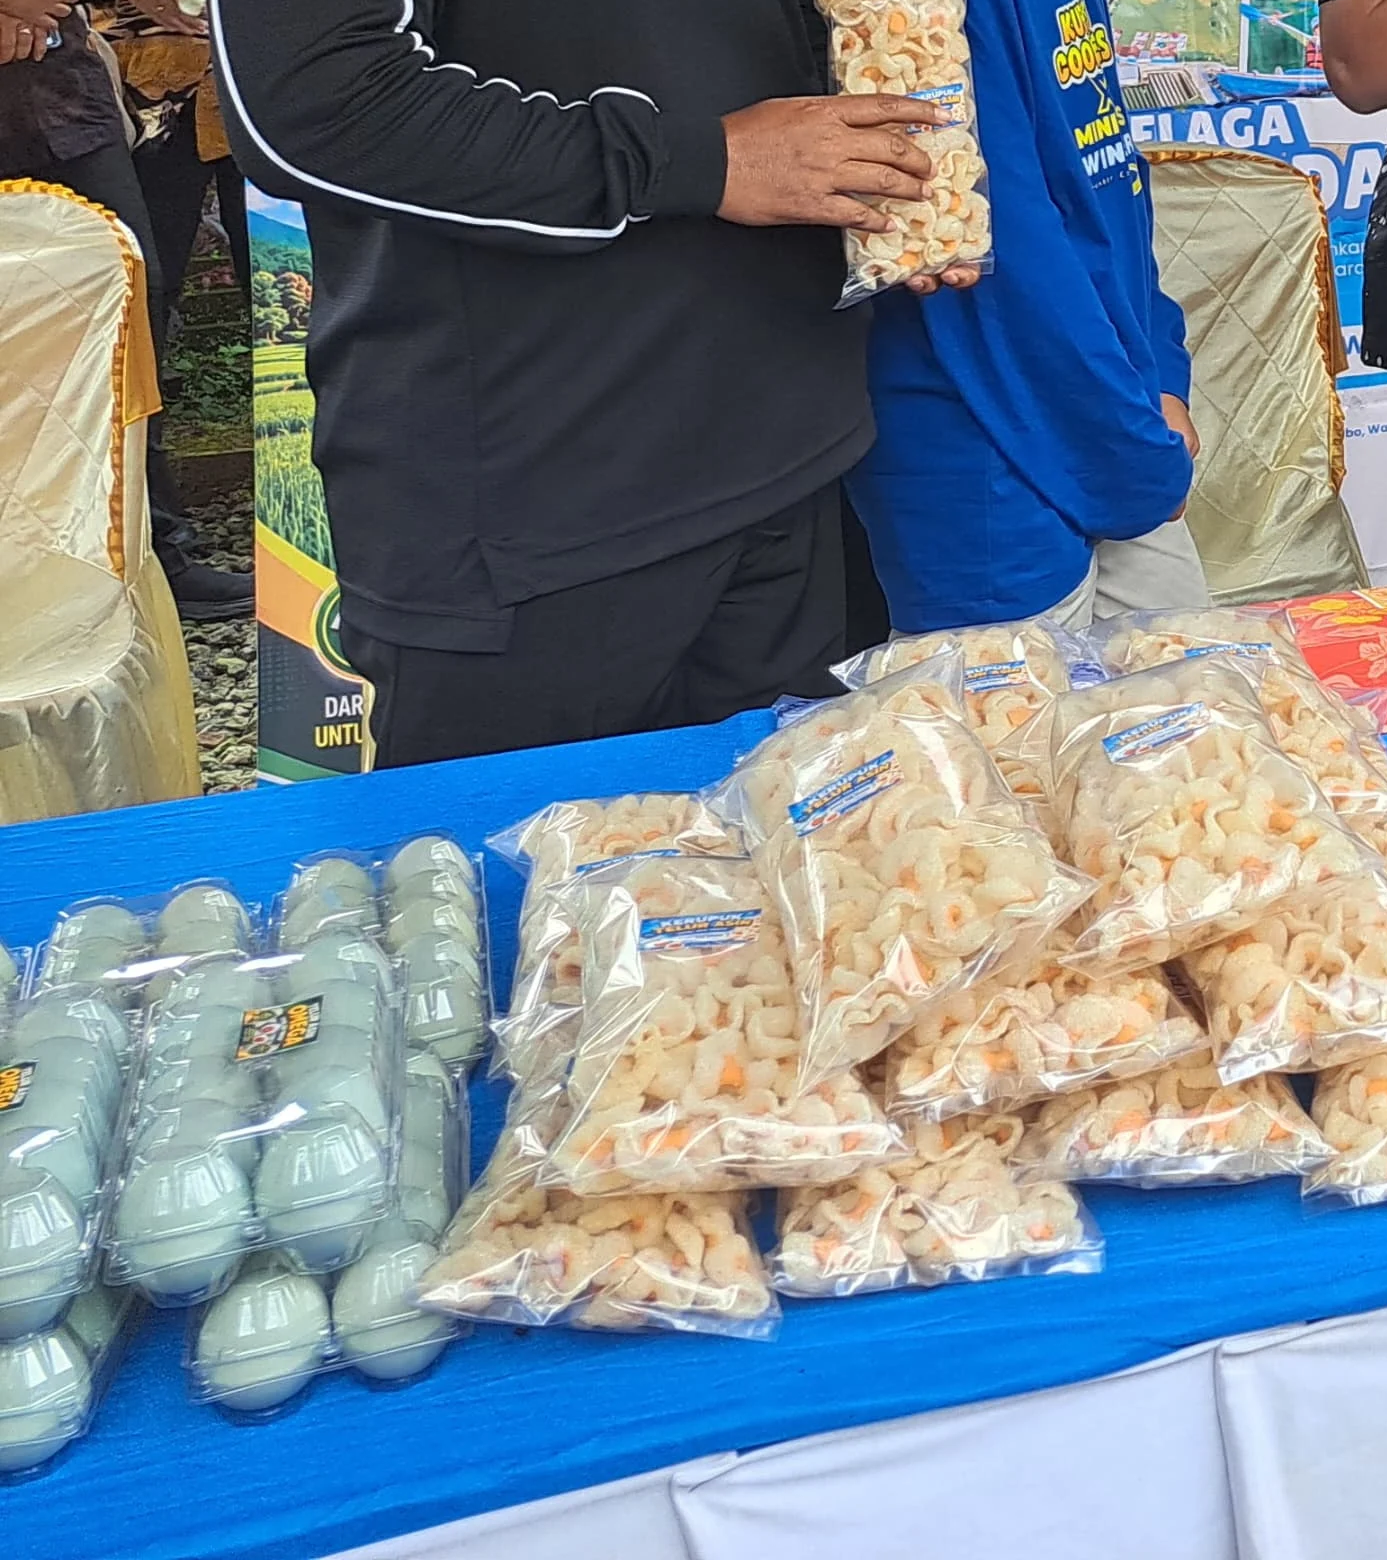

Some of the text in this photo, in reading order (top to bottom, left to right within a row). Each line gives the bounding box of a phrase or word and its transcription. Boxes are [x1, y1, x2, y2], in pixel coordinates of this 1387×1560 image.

[325, 694, 364, 718] DAR
[659, 912, 742, 928] KERUPUK
[282, 1004, 309, 1048] OMEGA
